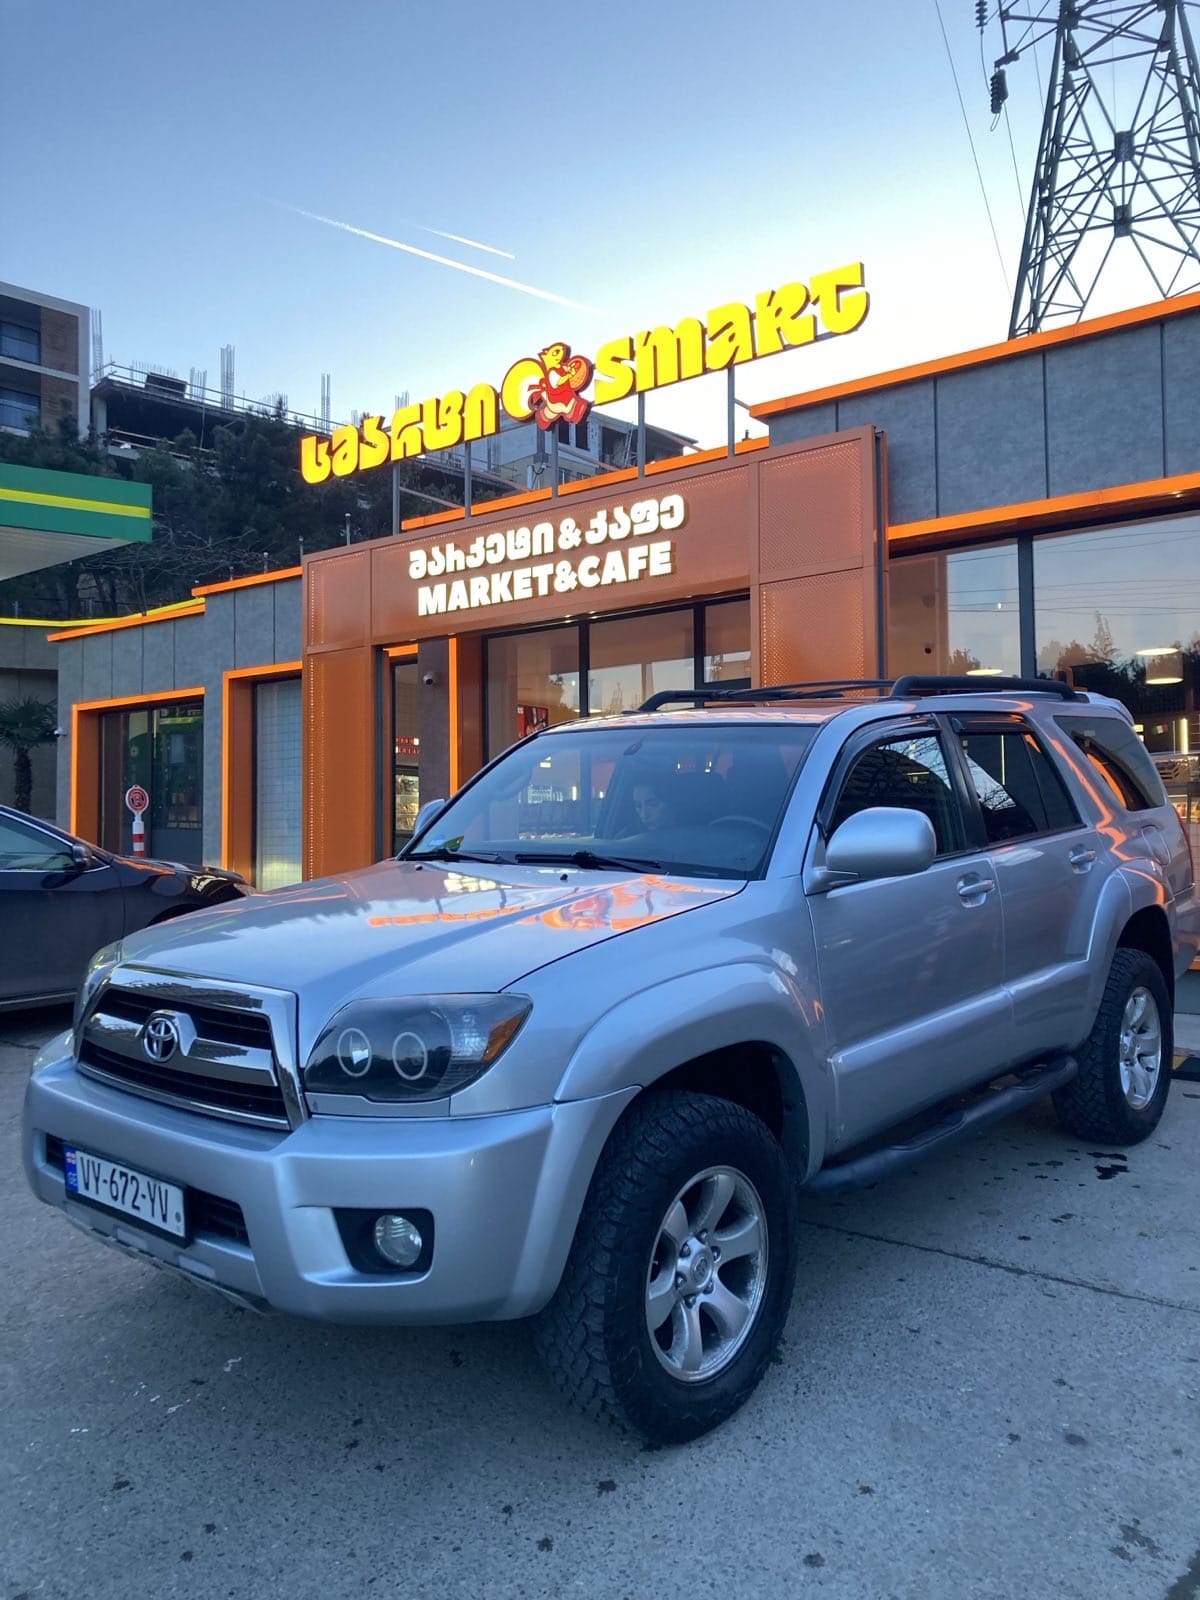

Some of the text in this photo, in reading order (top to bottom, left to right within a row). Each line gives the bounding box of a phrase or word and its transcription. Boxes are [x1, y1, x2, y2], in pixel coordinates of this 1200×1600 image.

[300, 382, 498, 485] სმარტი
[408, 494, 685, 580] მარკეტი & კაფე
[80, 1156, 169, 1224] VY-672-YV
